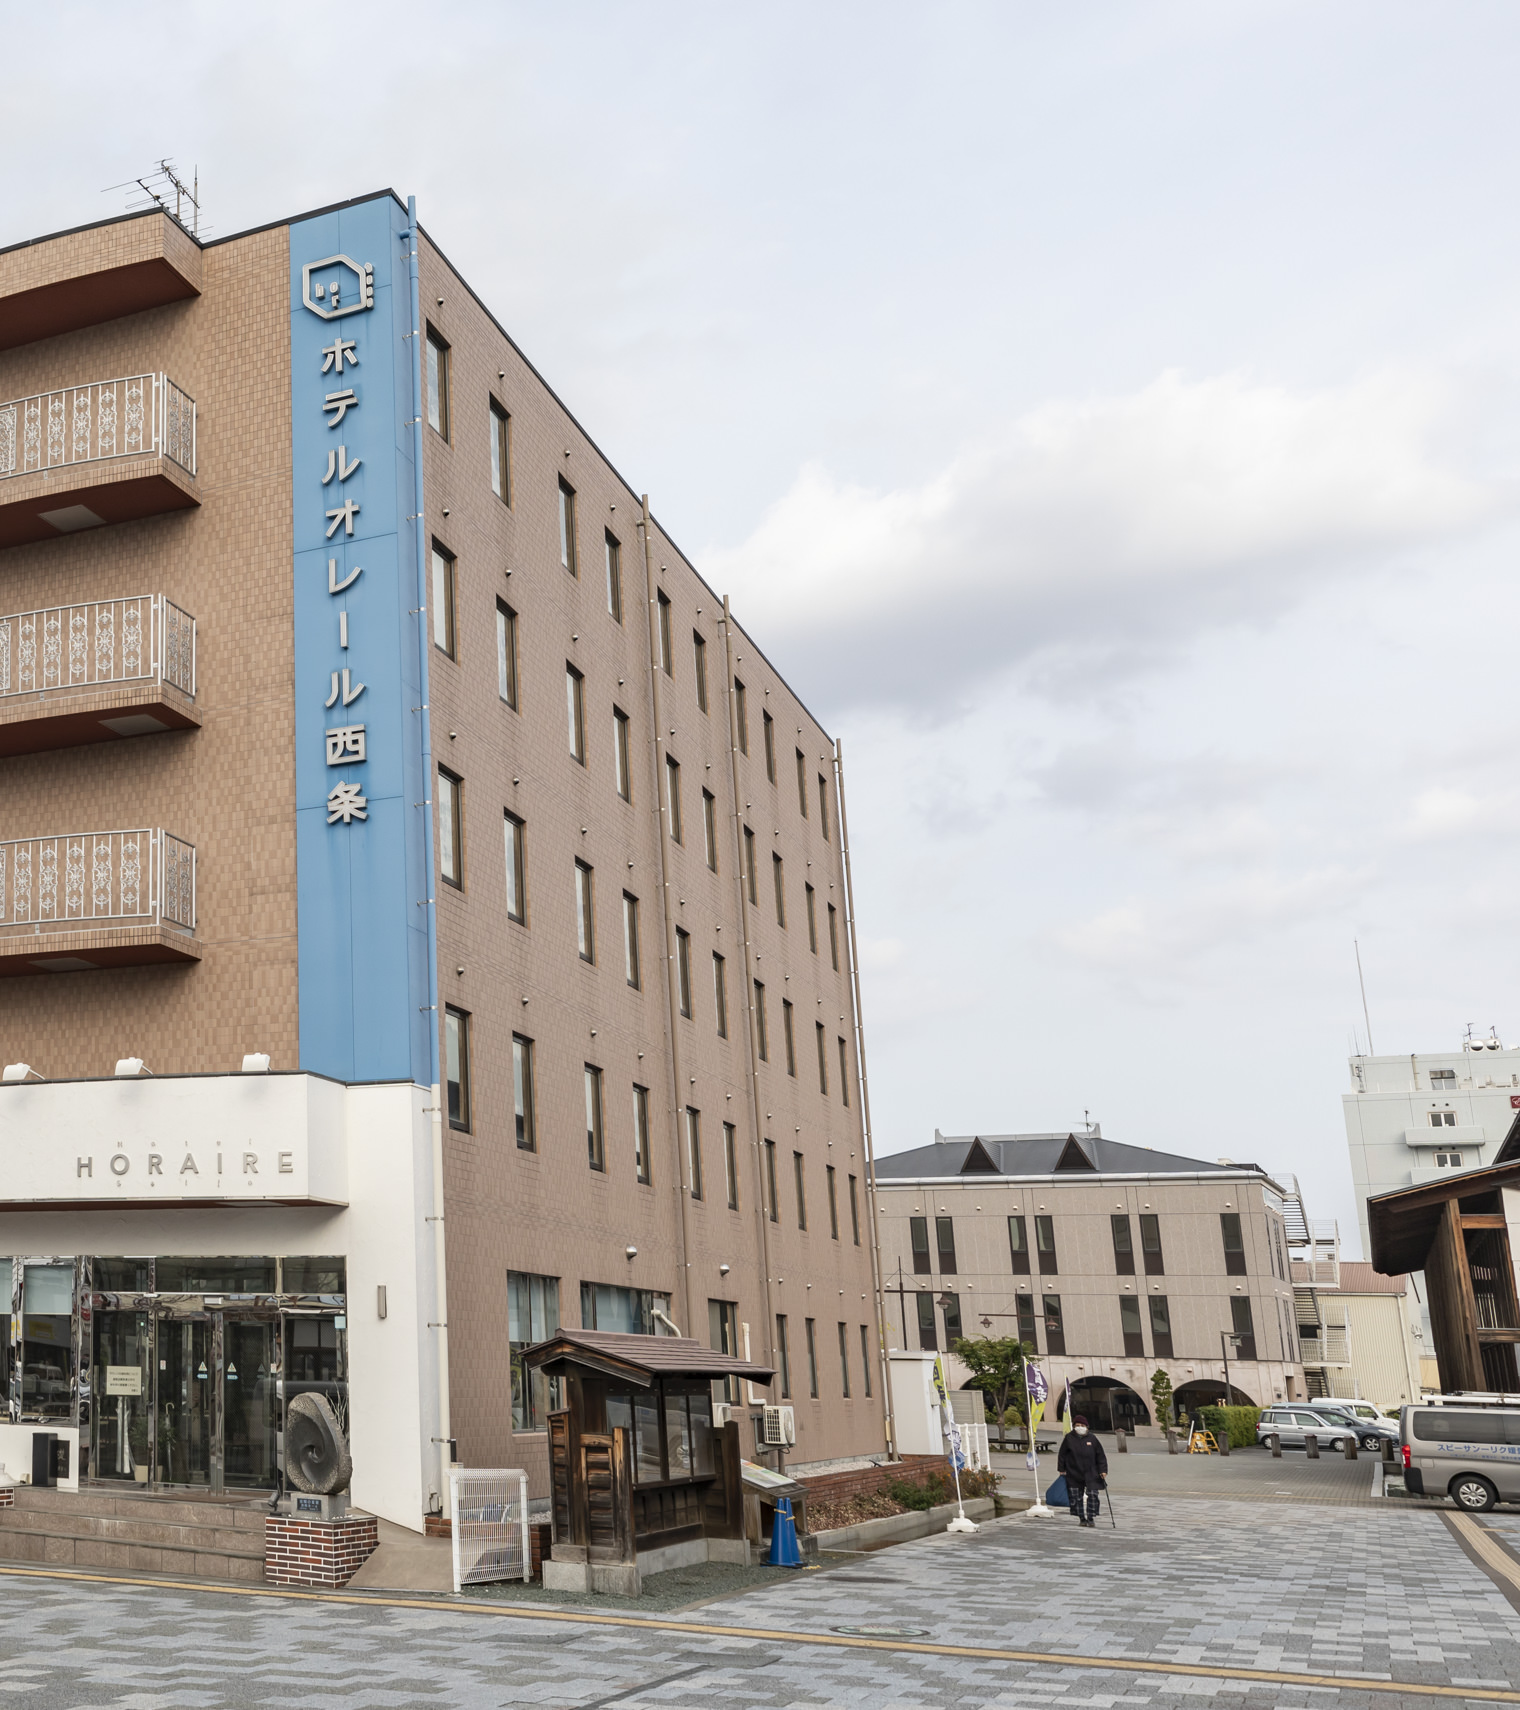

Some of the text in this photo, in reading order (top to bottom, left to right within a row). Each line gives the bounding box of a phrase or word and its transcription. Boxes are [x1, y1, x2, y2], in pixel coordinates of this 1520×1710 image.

[321, 338, 369, 825] ホテルオレール西条
[76, 1151, 294, 1178] HORAIRE
